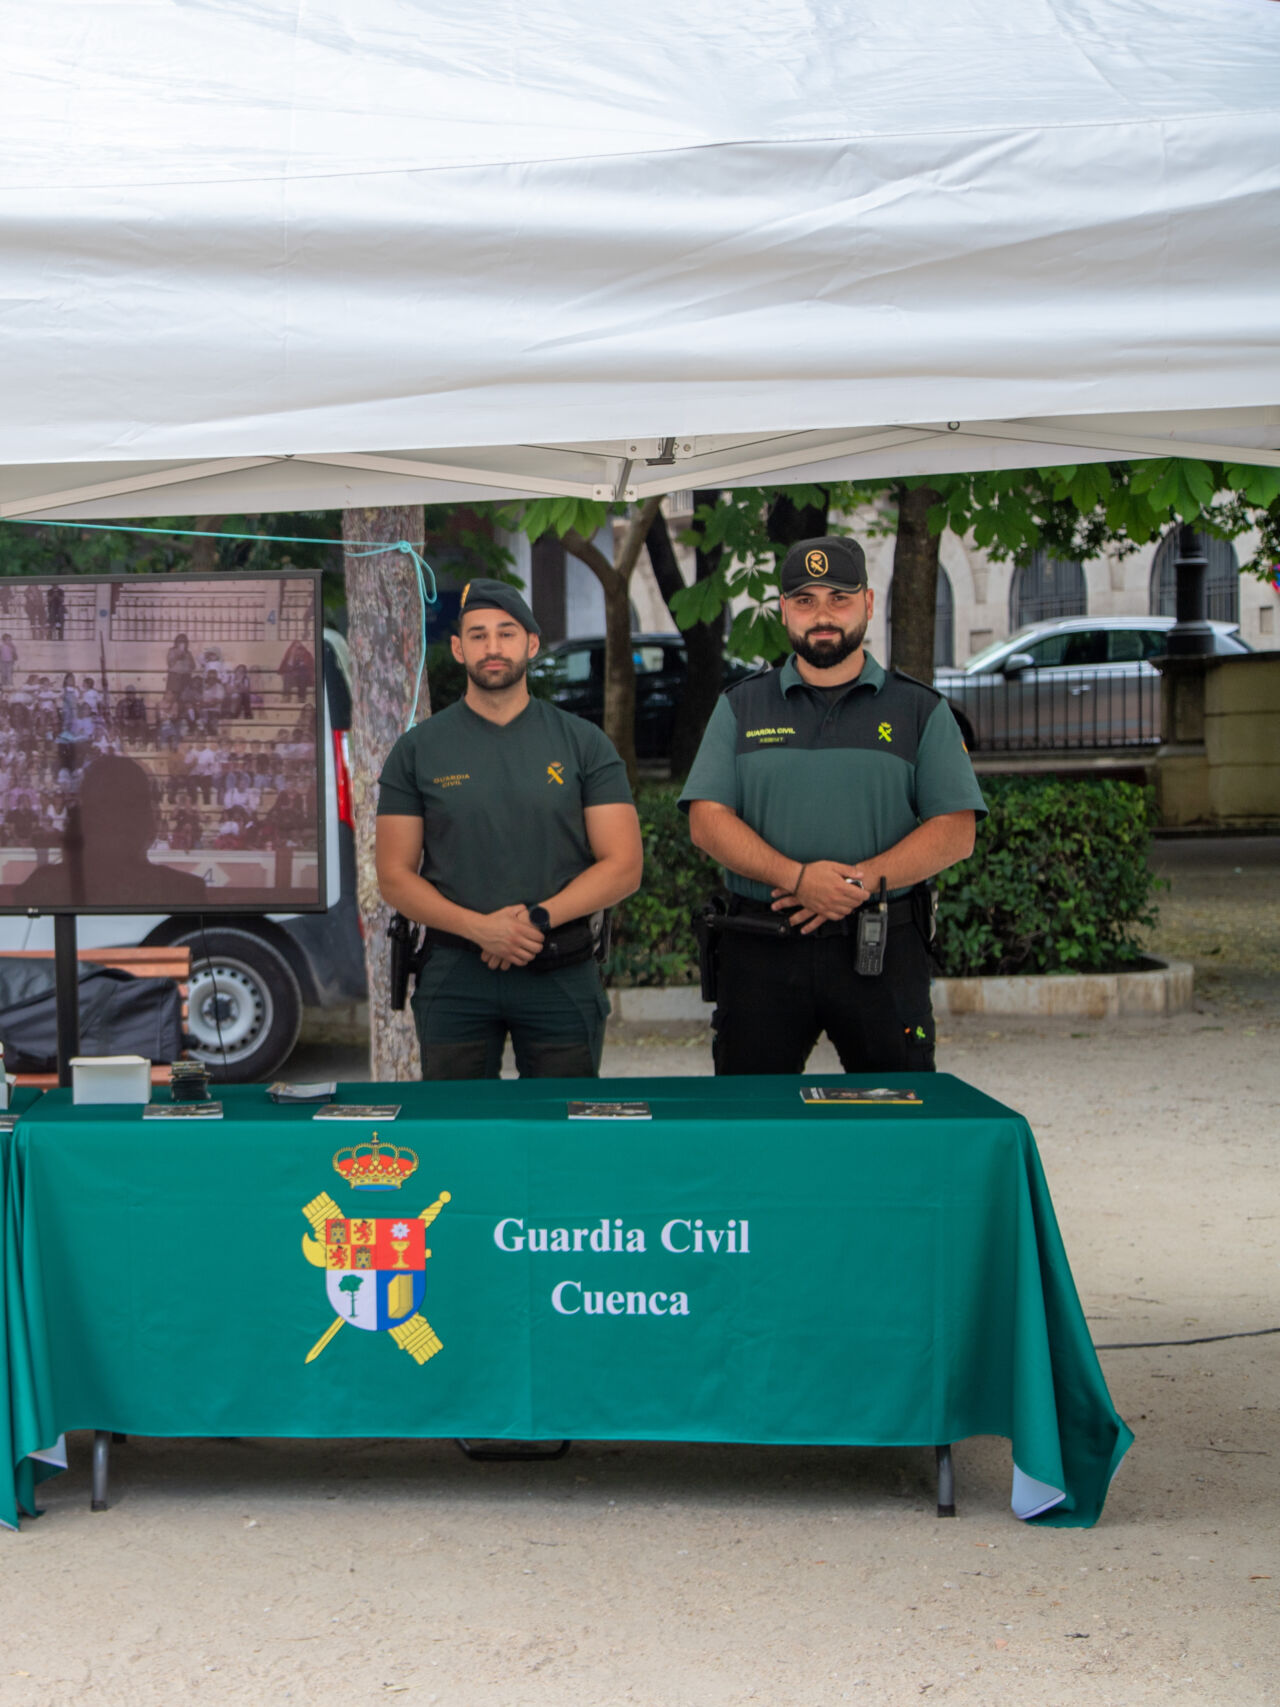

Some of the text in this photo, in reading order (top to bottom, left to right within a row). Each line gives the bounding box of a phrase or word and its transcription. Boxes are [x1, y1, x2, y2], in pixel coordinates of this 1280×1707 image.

[266, 609, 277, 625] 4
[745, 727, 796, 738] GUARDIA CIVIL
[433, 774, 470, 784] GUARDIA
[493, 1218, 751, 1253] Guardia Civil
[551, 1280, 691, 1316] Cuenca
